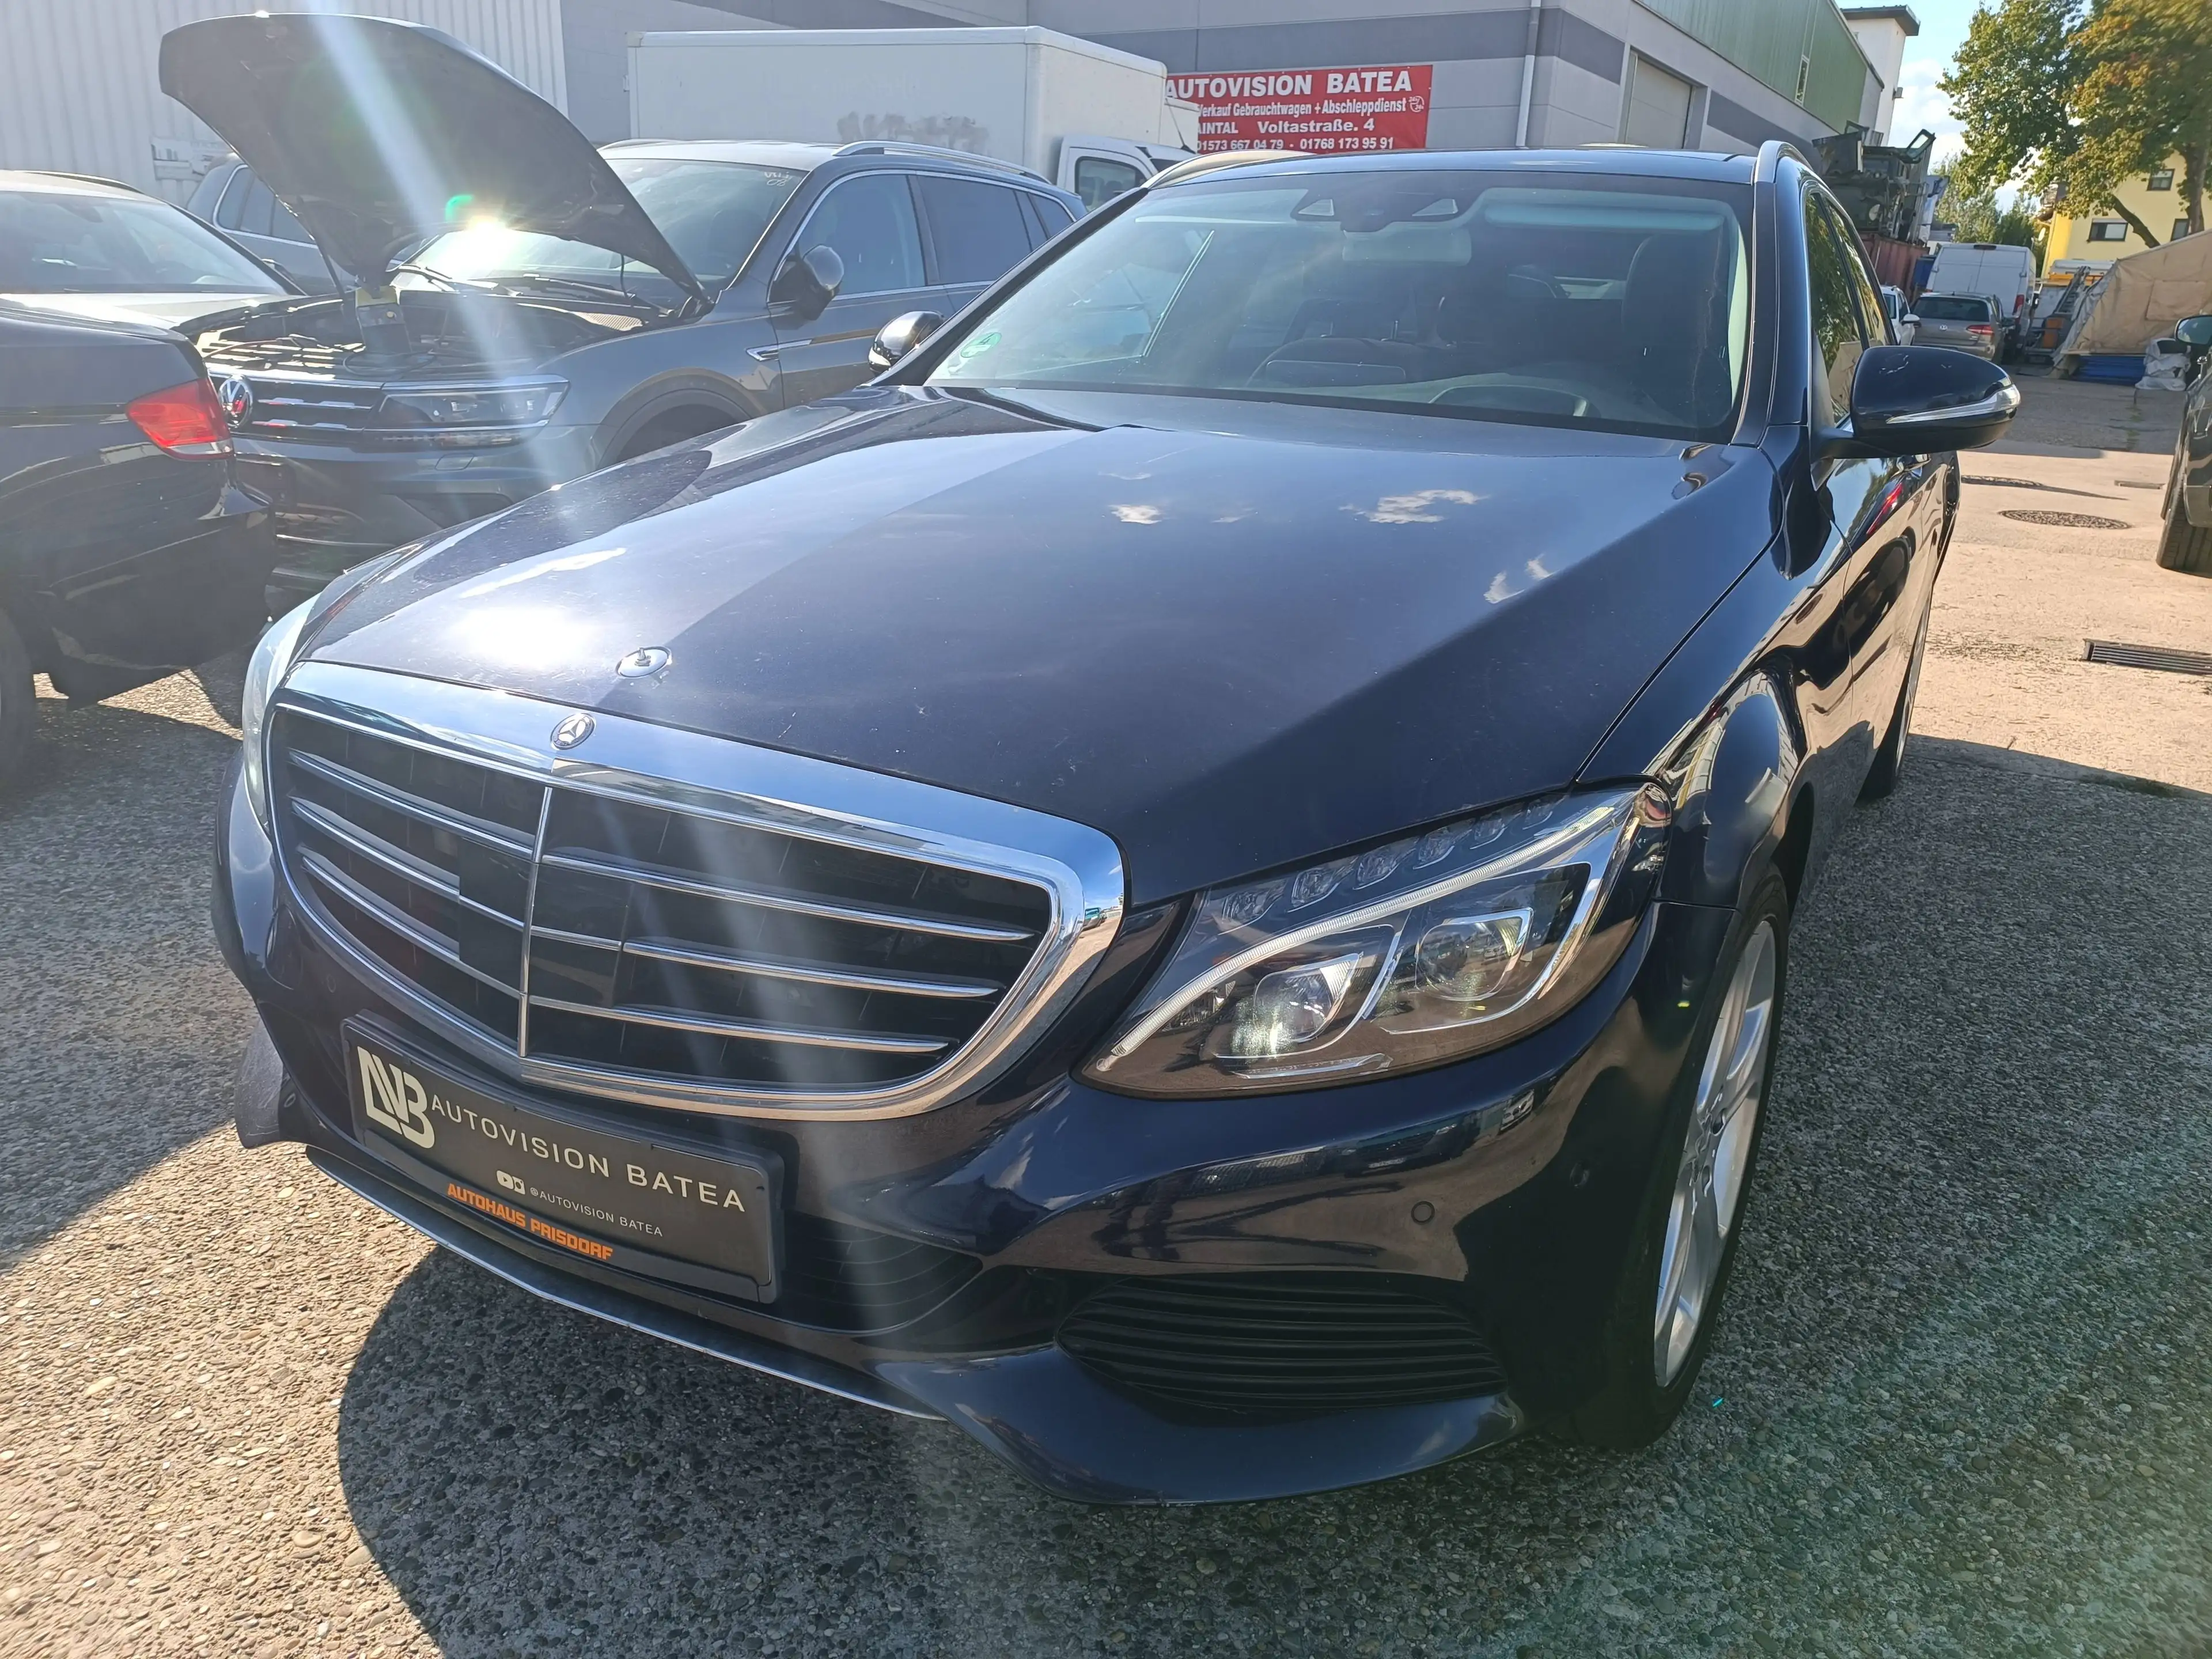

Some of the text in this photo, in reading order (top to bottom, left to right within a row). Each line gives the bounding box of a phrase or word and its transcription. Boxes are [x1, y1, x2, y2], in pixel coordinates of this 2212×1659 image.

[1166, 71, 1411, 98] AUTOVISION BATEA
[1233, 102, 1311, 118] Gebrauchtwagen
[1257, 119, 1358, 133] Voltastraße.
[1363, 118, 1374, 131] 4
[1230, 139, 1250, 150] 667
[1253, 139, 1266, 149] 04
[1270, 139, 1283, 149] 79
[1300, 138, 1334, 149] 01768
[1339, 137, 1359, 148] 173
[1362, 137, 1377, 148] 95
[1380, 137, 1393, 149] 91
[431, 1094, 745, 1212] AUTOVISION BATEA
[448, 1183, 613, 1260] AUTOHAUS PRISDORF
[530, 1187, 663, 1237] @AUTOVISION BATEA
